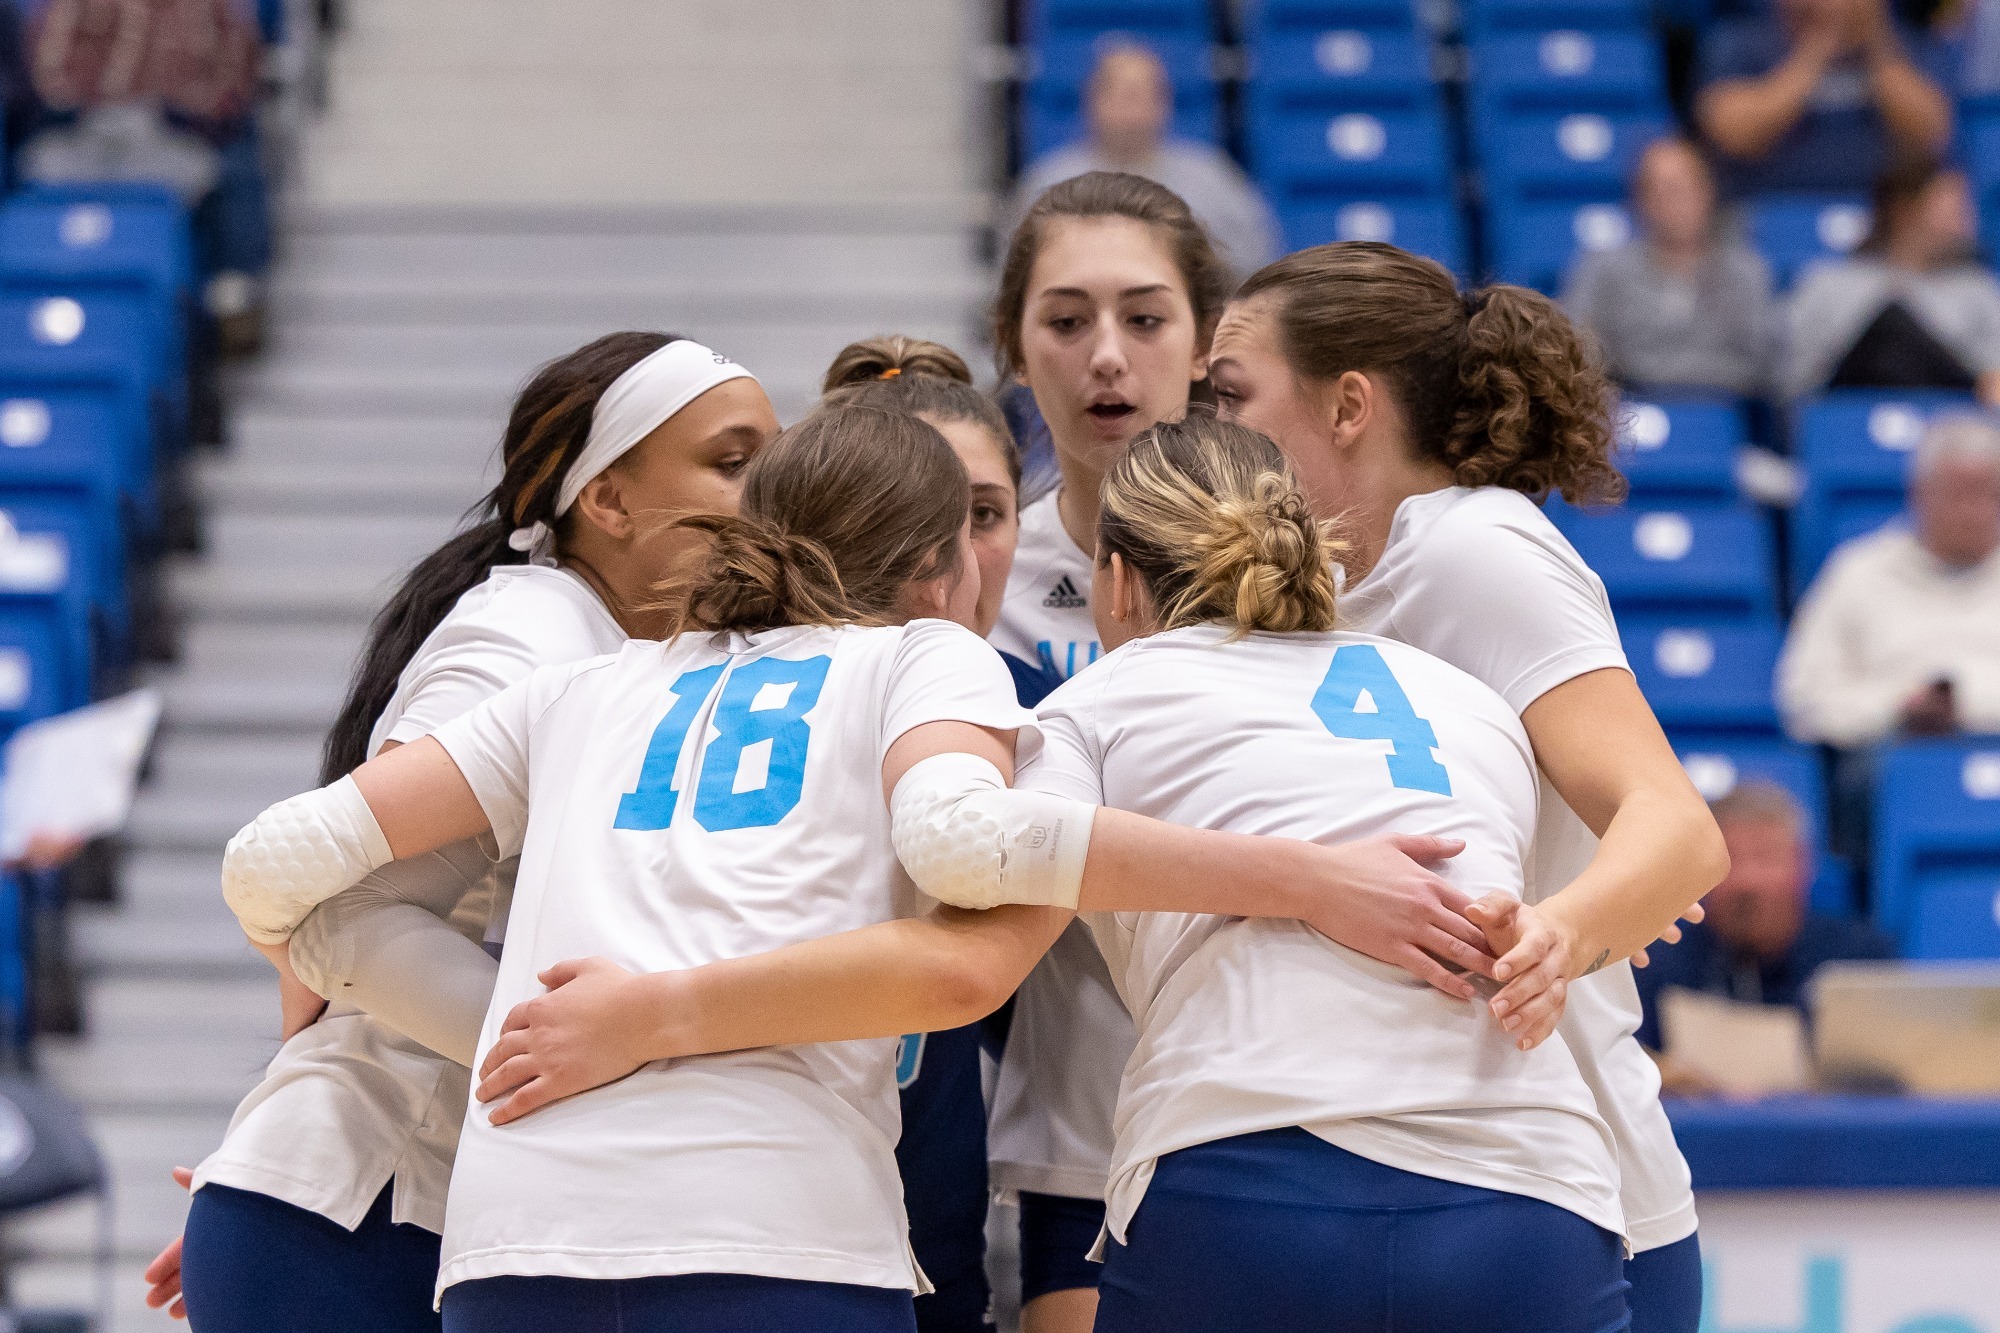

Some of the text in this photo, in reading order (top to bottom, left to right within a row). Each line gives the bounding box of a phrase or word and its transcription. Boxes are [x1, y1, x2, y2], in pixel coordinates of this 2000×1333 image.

[1043, 597, 1087, 608] adidas
[613, 654, 832, 832] 18
[1310, 644, 1452, 797] 4
